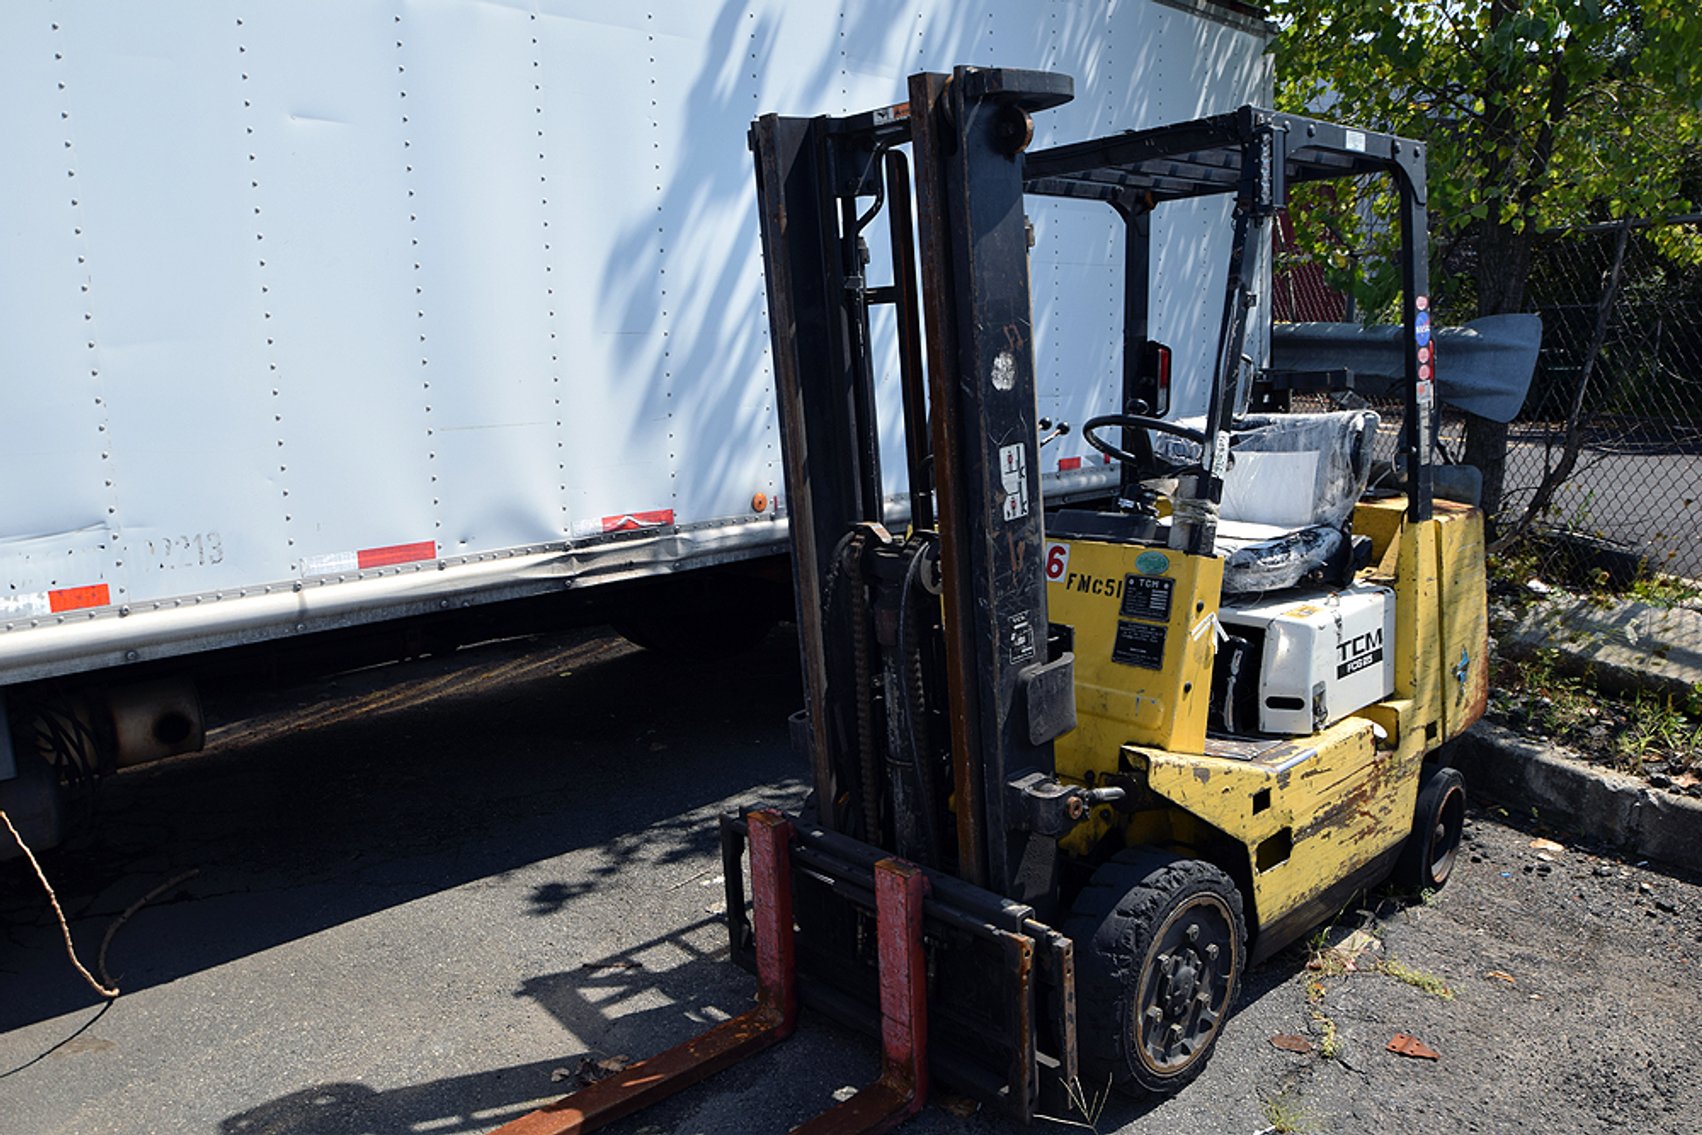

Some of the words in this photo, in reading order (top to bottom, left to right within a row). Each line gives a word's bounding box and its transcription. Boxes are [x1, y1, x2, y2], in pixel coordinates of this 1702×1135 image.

[1046, 545, 1067, 579] 6
[1138, 578, 1160, 589] TCM
[1336, 627, 1383, 662] TCM
